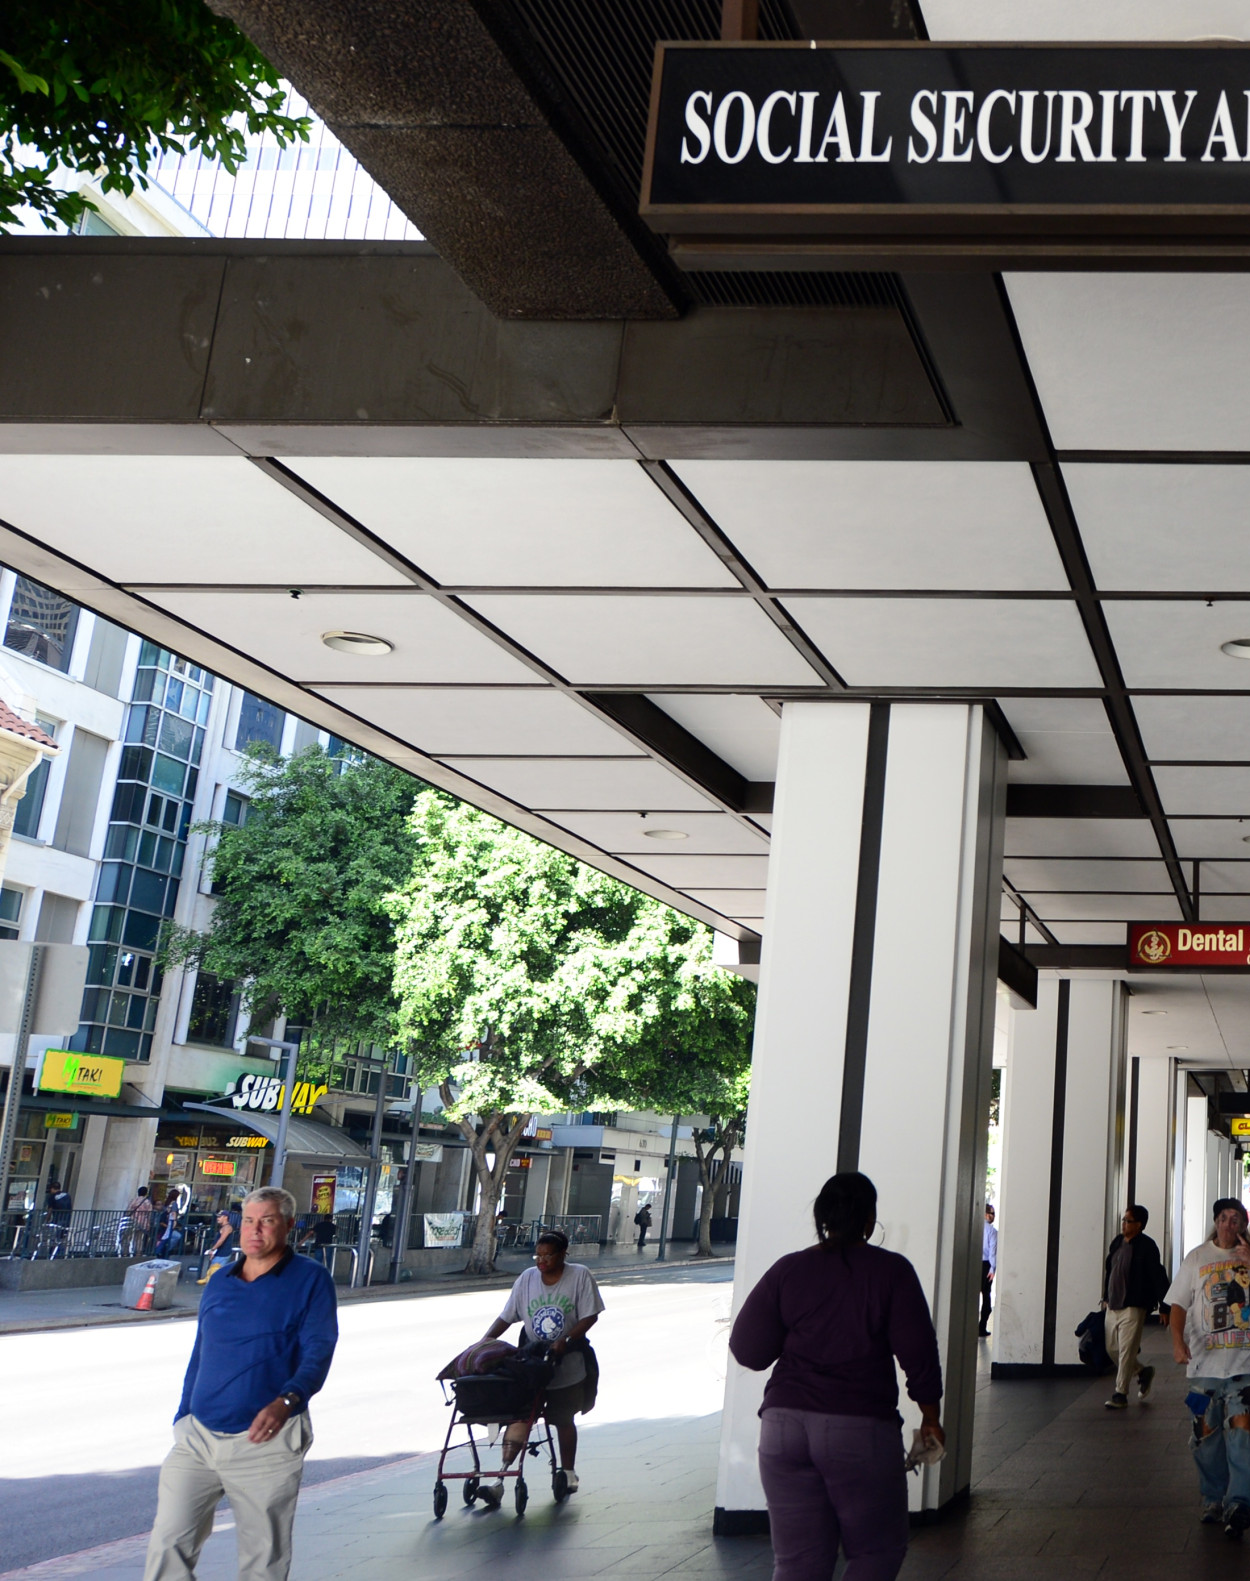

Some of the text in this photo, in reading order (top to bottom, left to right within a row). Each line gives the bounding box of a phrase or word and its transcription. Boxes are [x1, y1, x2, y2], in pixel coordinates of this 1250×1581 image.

[680, 90, 893, 165] SOCIAL
[907, 89, 1198, 165] SECURITY
[1177, 928, 1244, 952] Dental
[226, 1136, 270, 1148] SUBWAY
